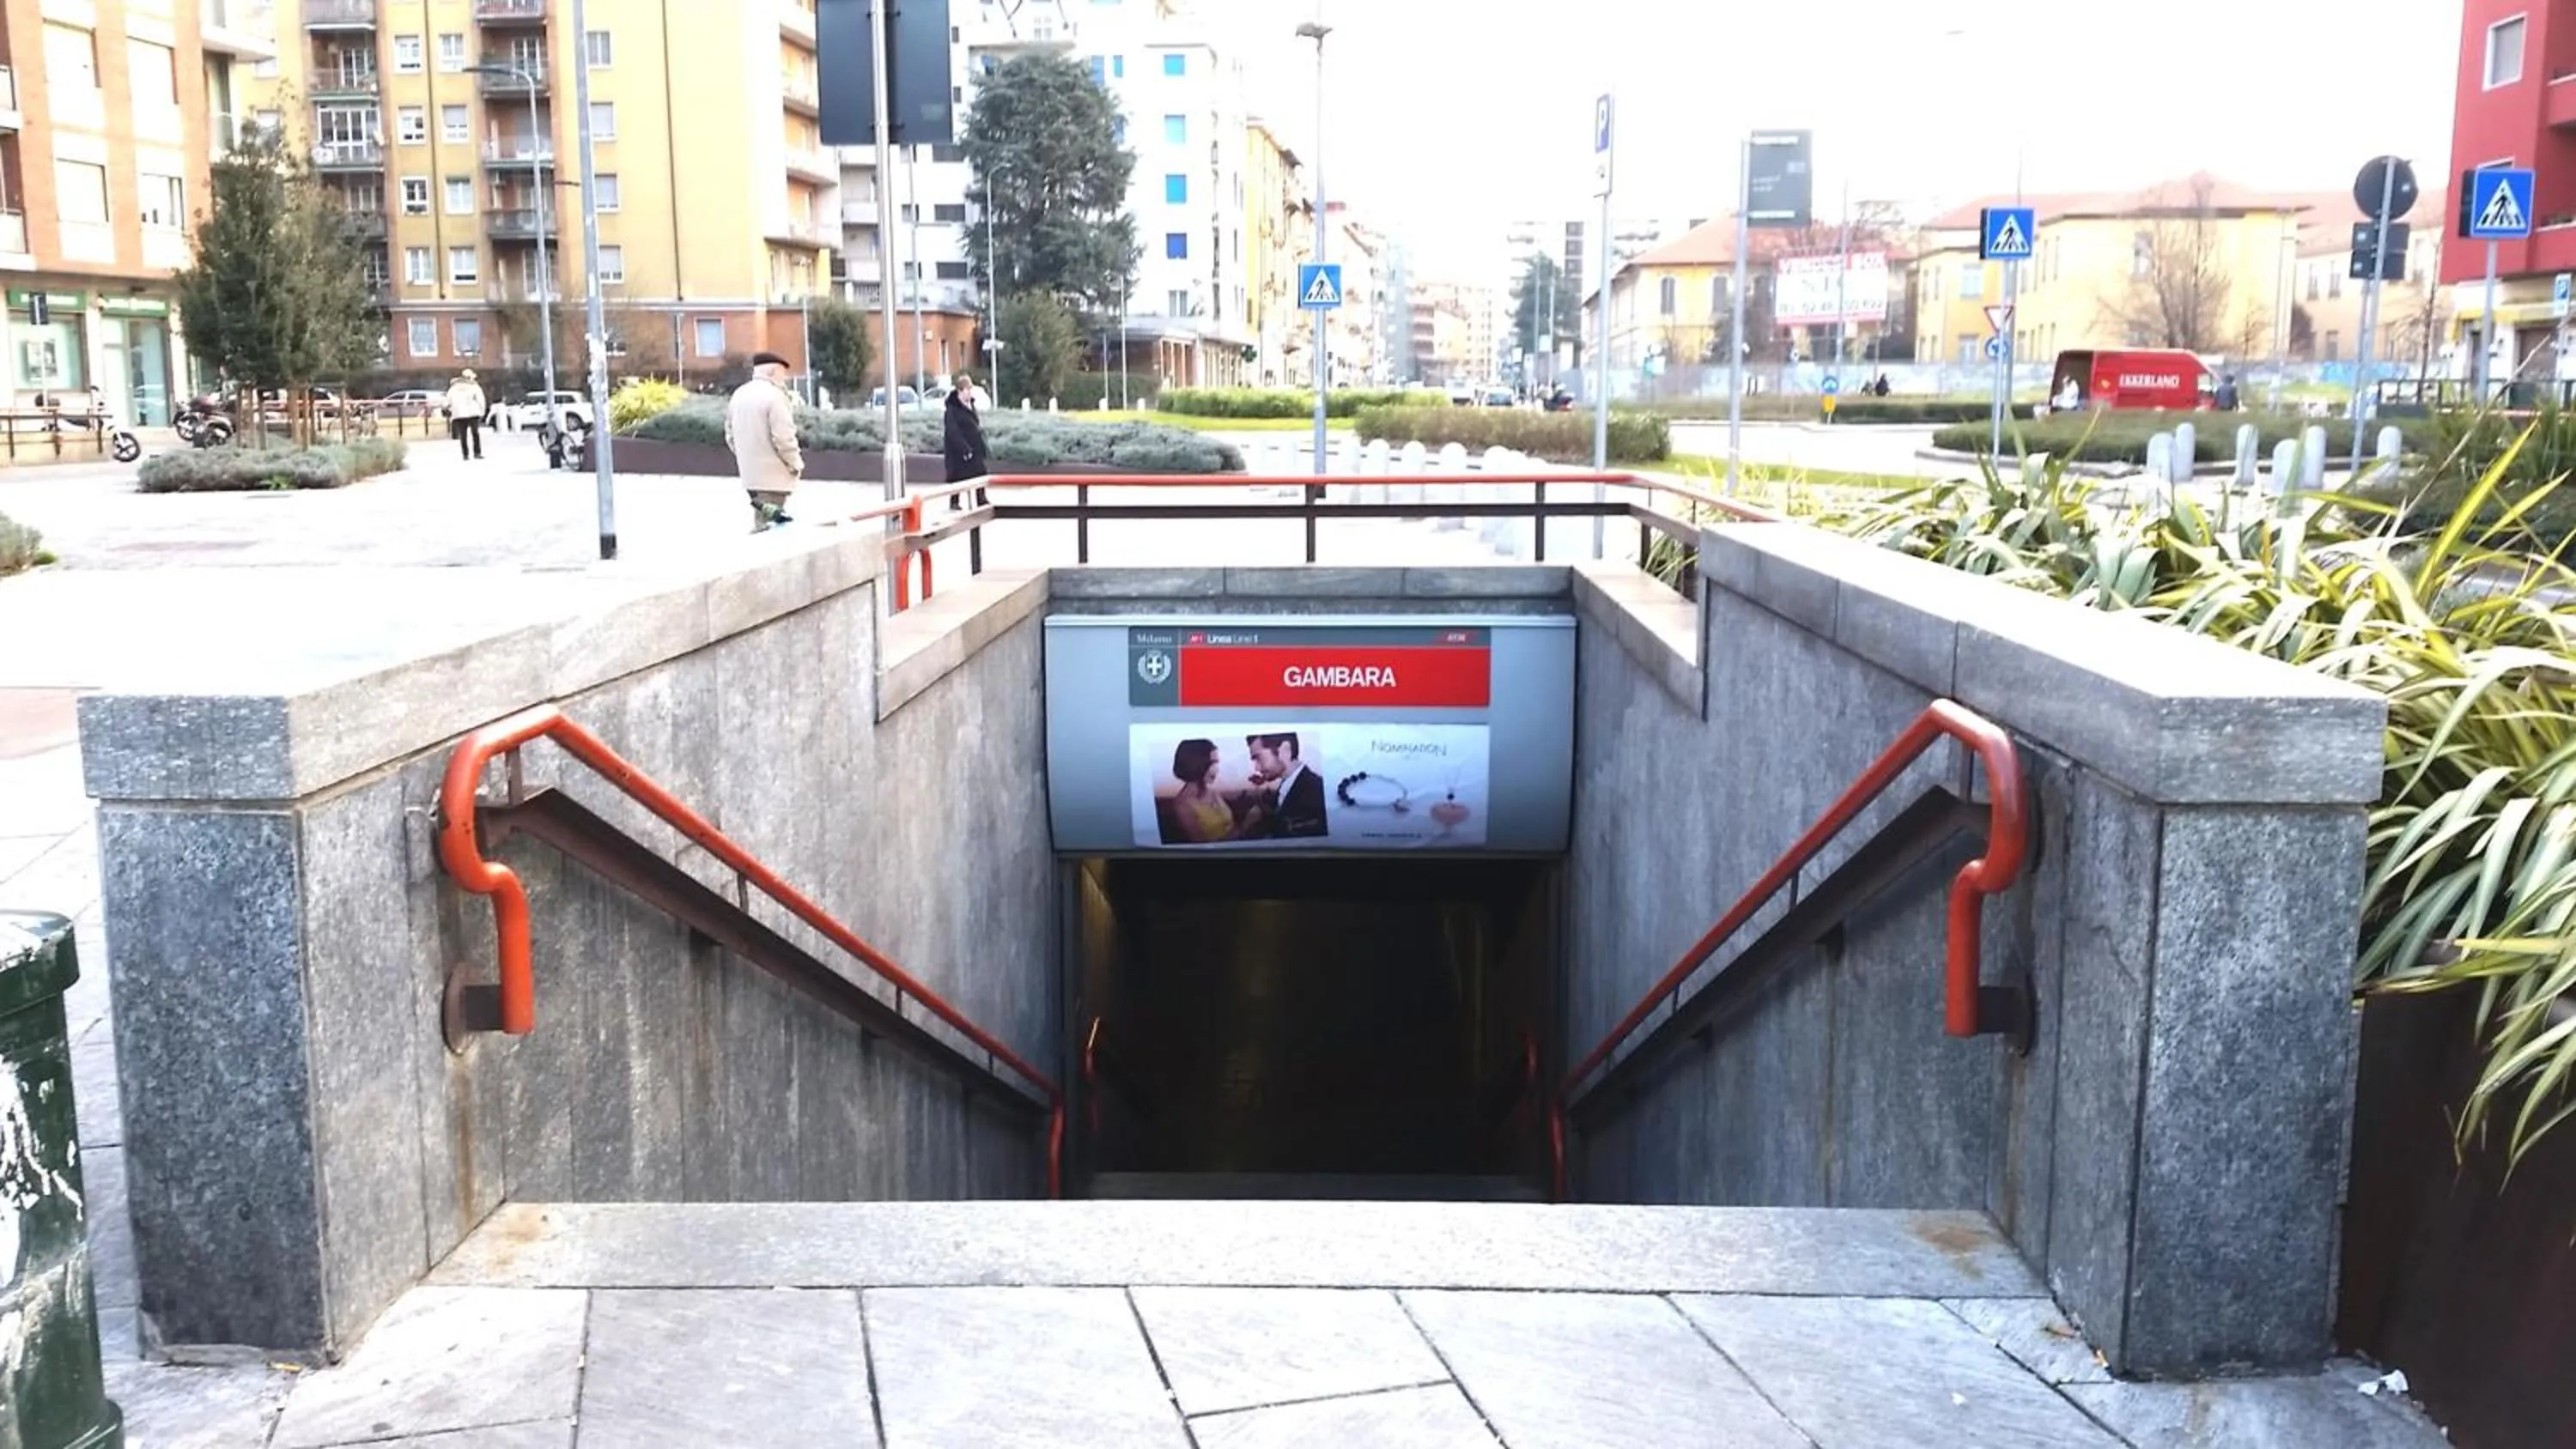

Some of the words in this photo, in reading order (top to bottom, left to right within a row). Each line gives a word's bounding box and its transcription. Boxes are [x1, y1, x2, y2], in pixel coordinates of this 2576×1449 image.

[1137, 633, 1172, 644] Milano
[1207, 634, 1232, 644] Linea
[1283, 666, 1397, 688] GAMBARA
